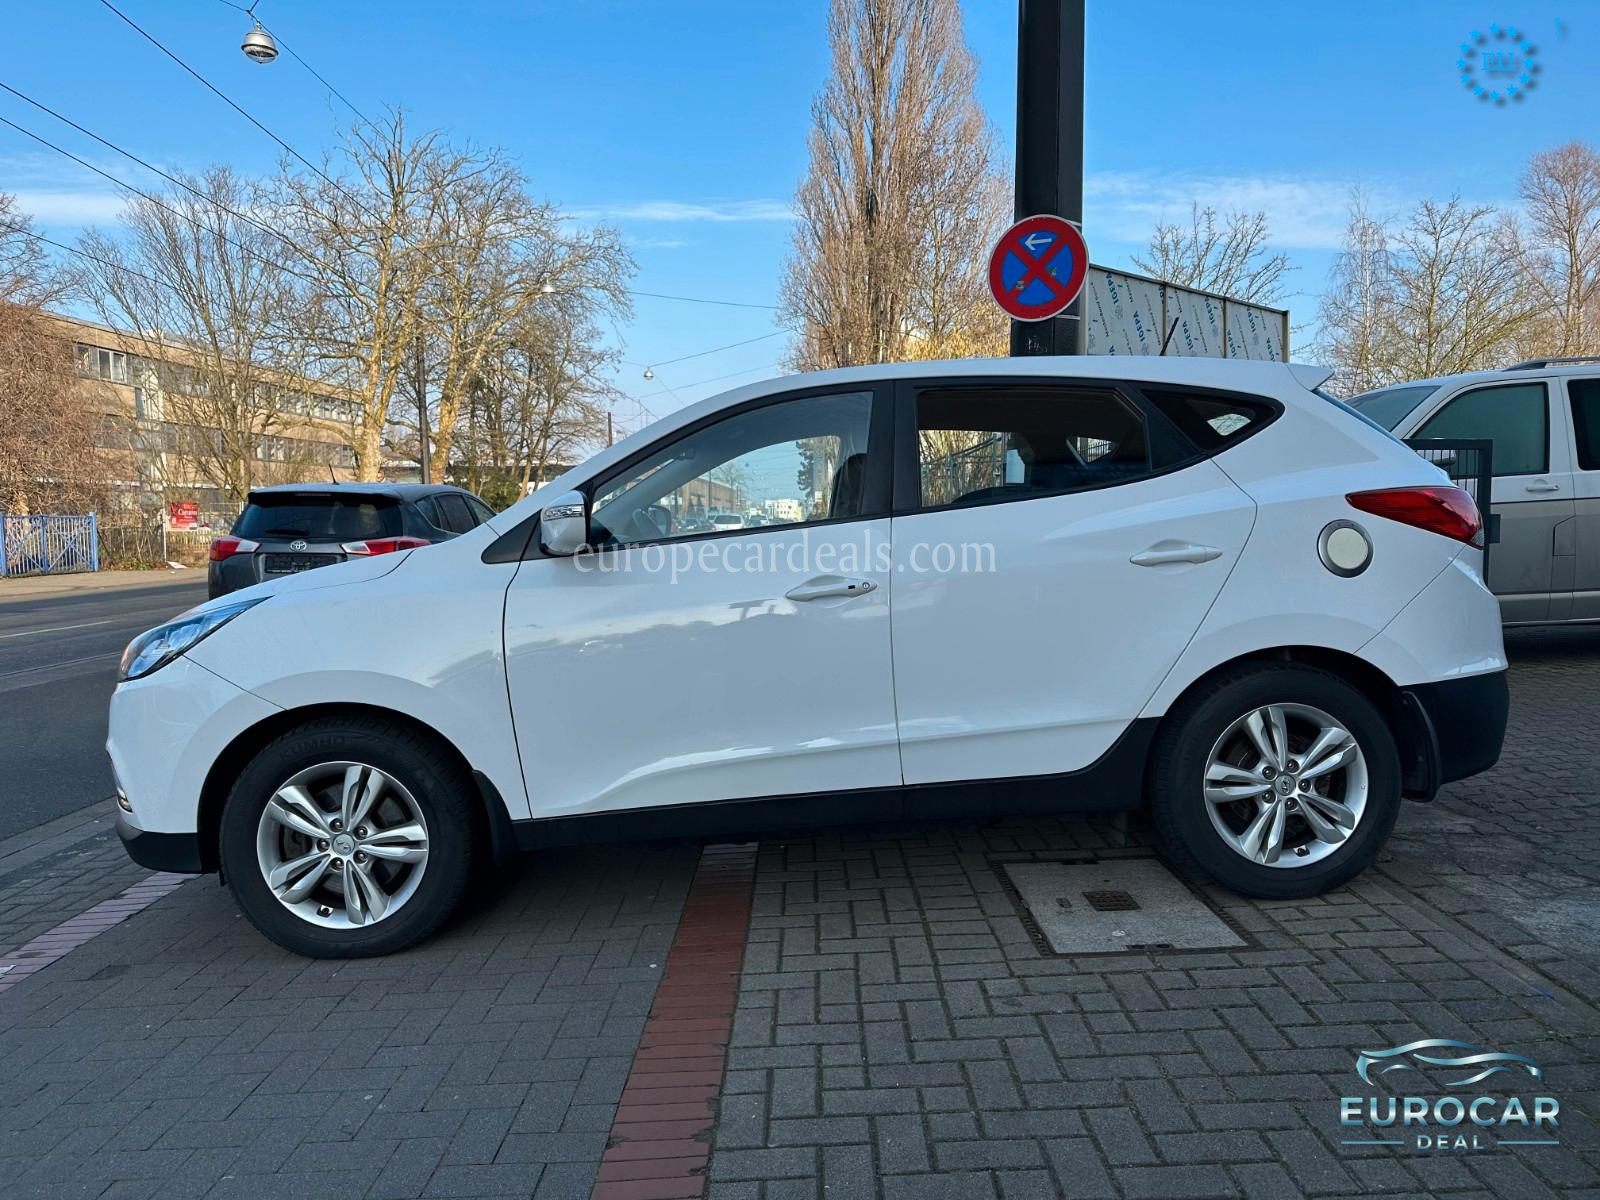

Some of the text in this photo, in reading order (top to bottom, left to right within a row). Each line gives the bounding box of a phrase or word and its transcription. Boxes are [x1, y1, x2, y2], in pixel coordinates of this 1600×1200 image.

[1105, 271, 1119, 305] IGEPA
[1133, 309, 1146, 342] IGEPA
[1182, 320, 1195, 350] IGEPA
